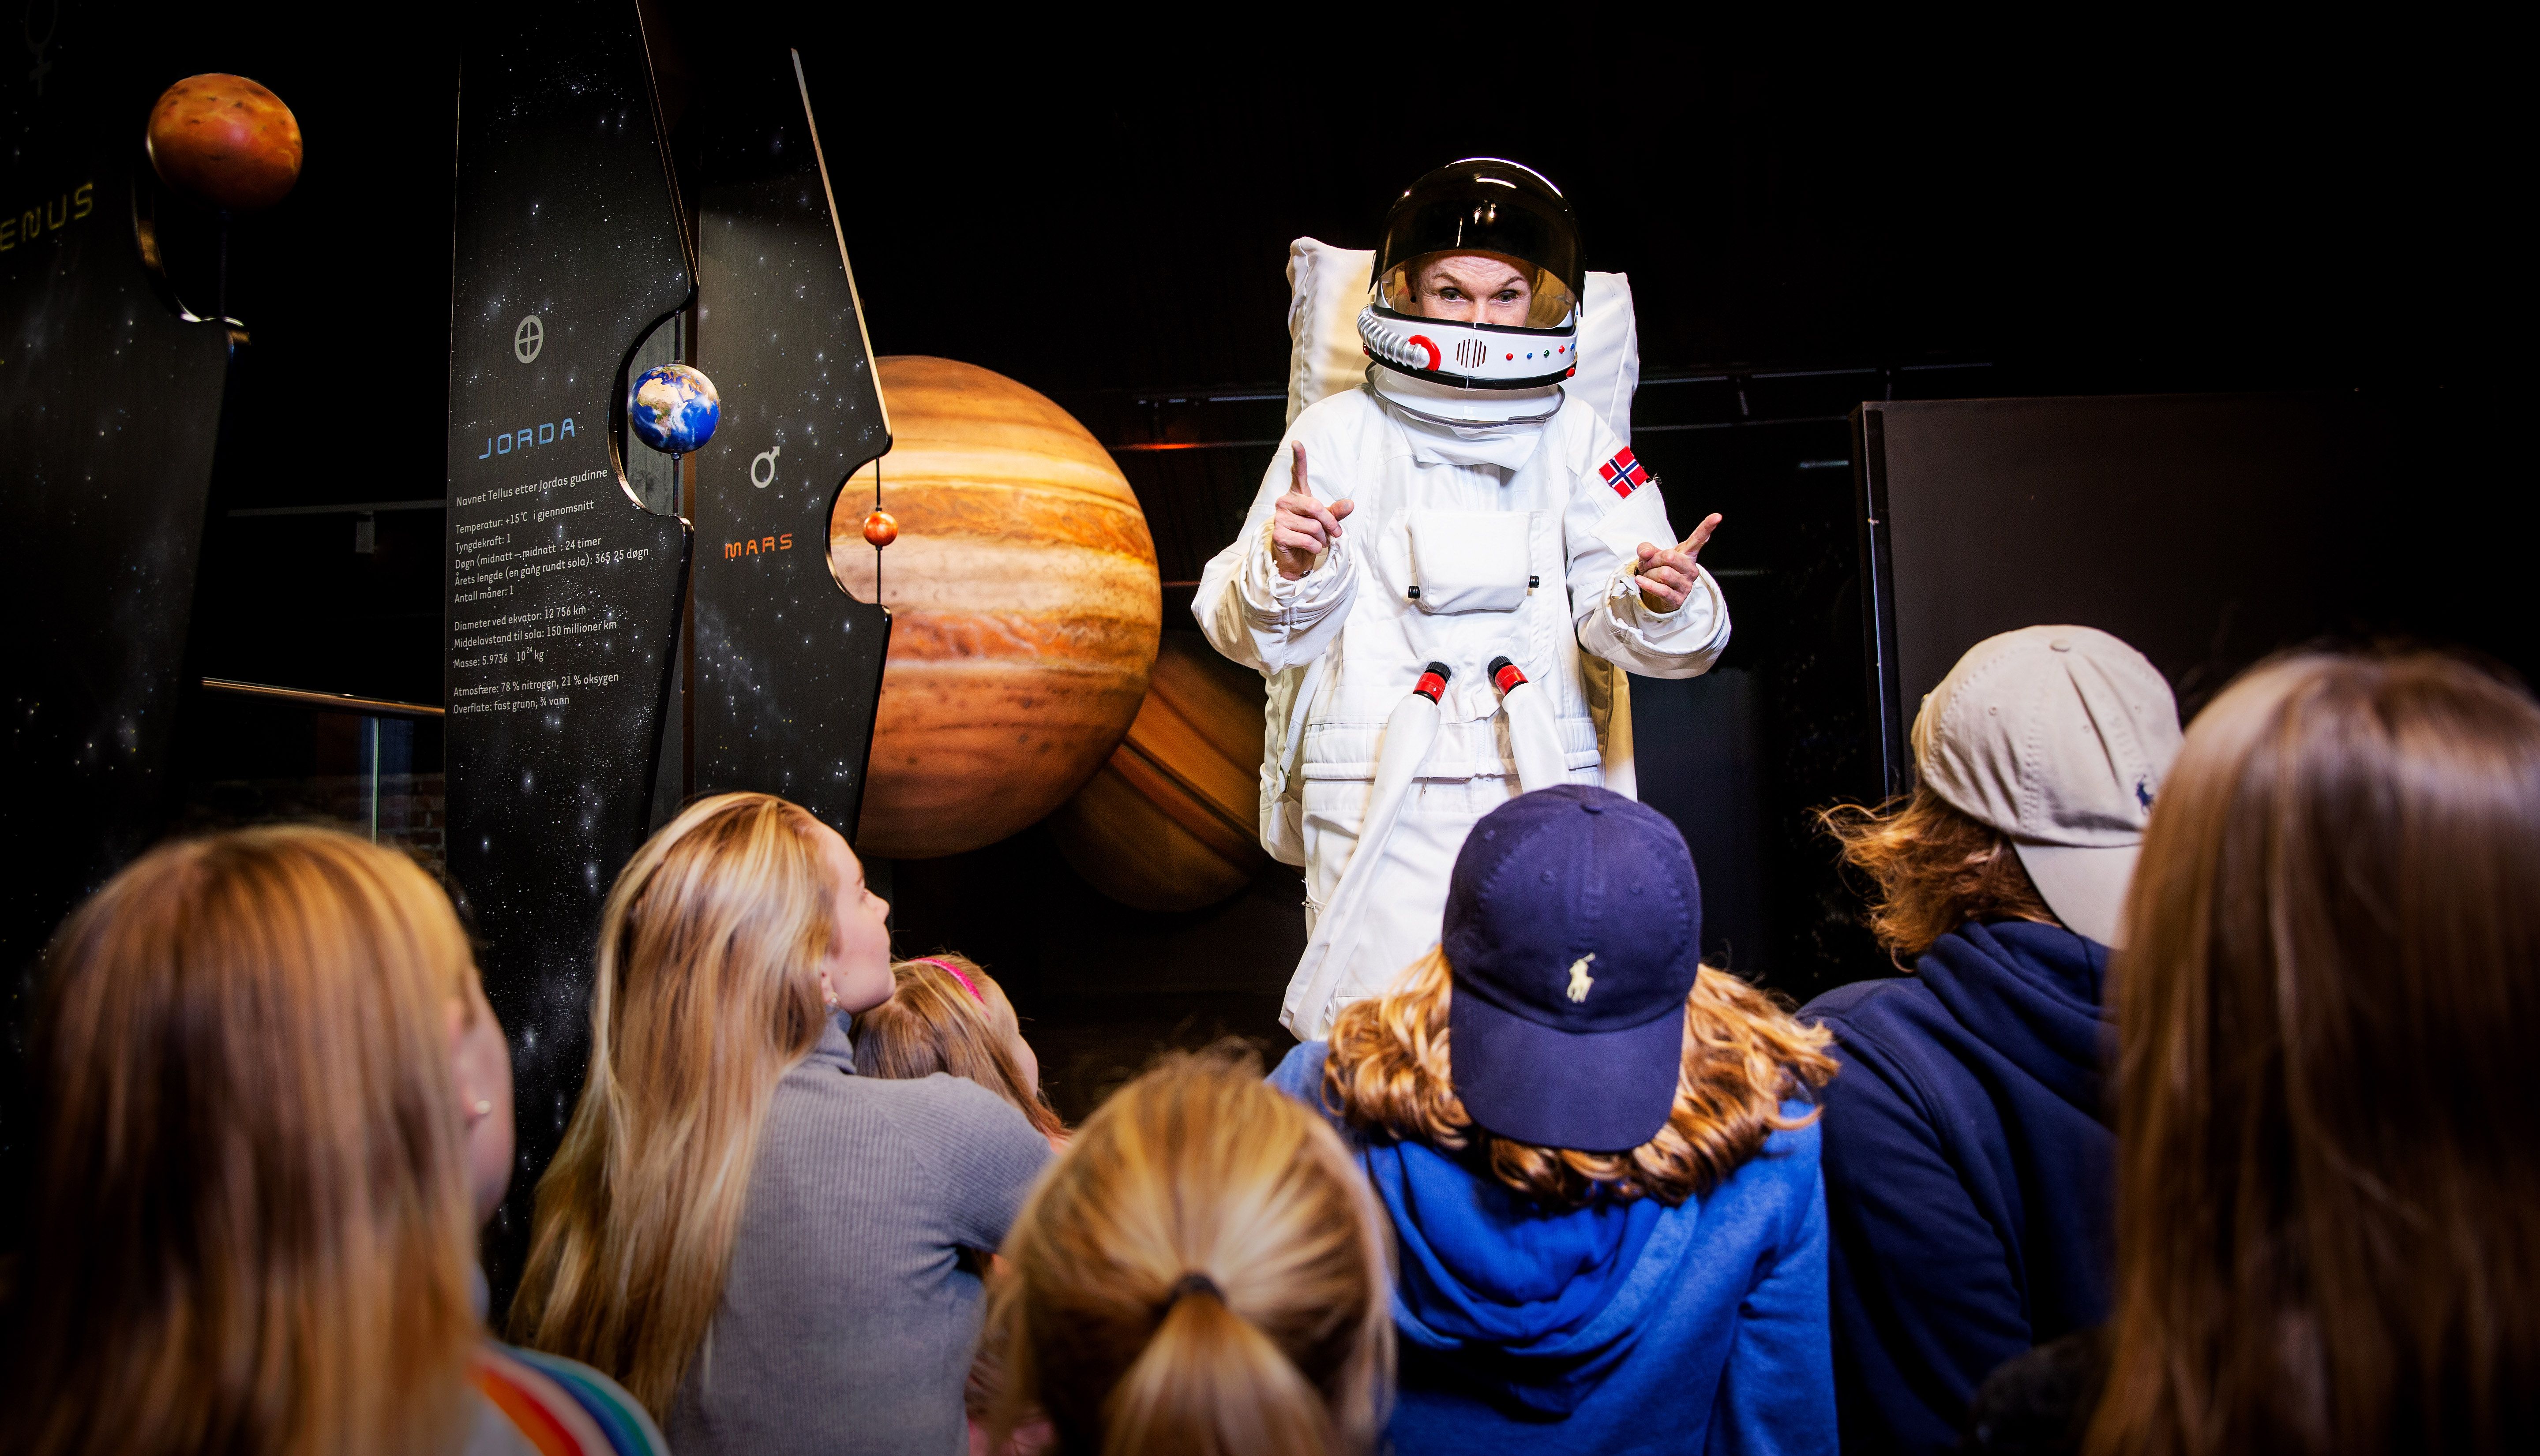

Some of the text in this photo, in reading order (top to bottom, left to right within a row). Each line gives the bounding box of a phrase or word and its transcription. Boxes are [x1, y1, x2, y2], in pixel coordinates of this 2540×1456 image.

[479, 418, 575, 460] JORDA
[457, 469, 608, 507] Navnet Tellus etter Jordas gudinne
[456, 519, 503, 534] Temperatur:
[533, 510, 536, 520] i
[537, 500, 594, 522] gjennomsnitt
[455, 533, 510, 554] Tyngdekraft: 1
[456, 560, 474, 570] Døgn
[477, 552, 513, 567] (midnatt
[522, 544, 556, 558] midnatt
[566, 539, 575, 550] 24
[578, 538, 601, 548] timer
[725, 533, 792, 559] MARS
[455, 572, 475, 586] Årets
[477, 570, 503, 584] lengde
[506, 566, 518, 580] (en
[521, 565, 540, 579] gang
[543, 560, 566, 572] rundt
[568, 552, 593, 567] sola):
[596, 552, 611, 564] 365
[627, 548, 649, 560] døgn
[454, 585, 514, 603] Antall måner: 1
[454, 605, 586, 631] Diameter ved ekvator: 12 756 km
[454, 620, 617, 648] Middelavstand til sola: 150 millioner km
[454, 659, 480, 668] Masse:
[482, 653, 508, 665] 5.9736
[535, 650, 544, 662] kg
[454, 674, 619, 696] Atmosfære: 78 % nitrogen, 21 % oksygen
[494, 701, 510, 711] fast
[549, 697, 570, 706] vann
